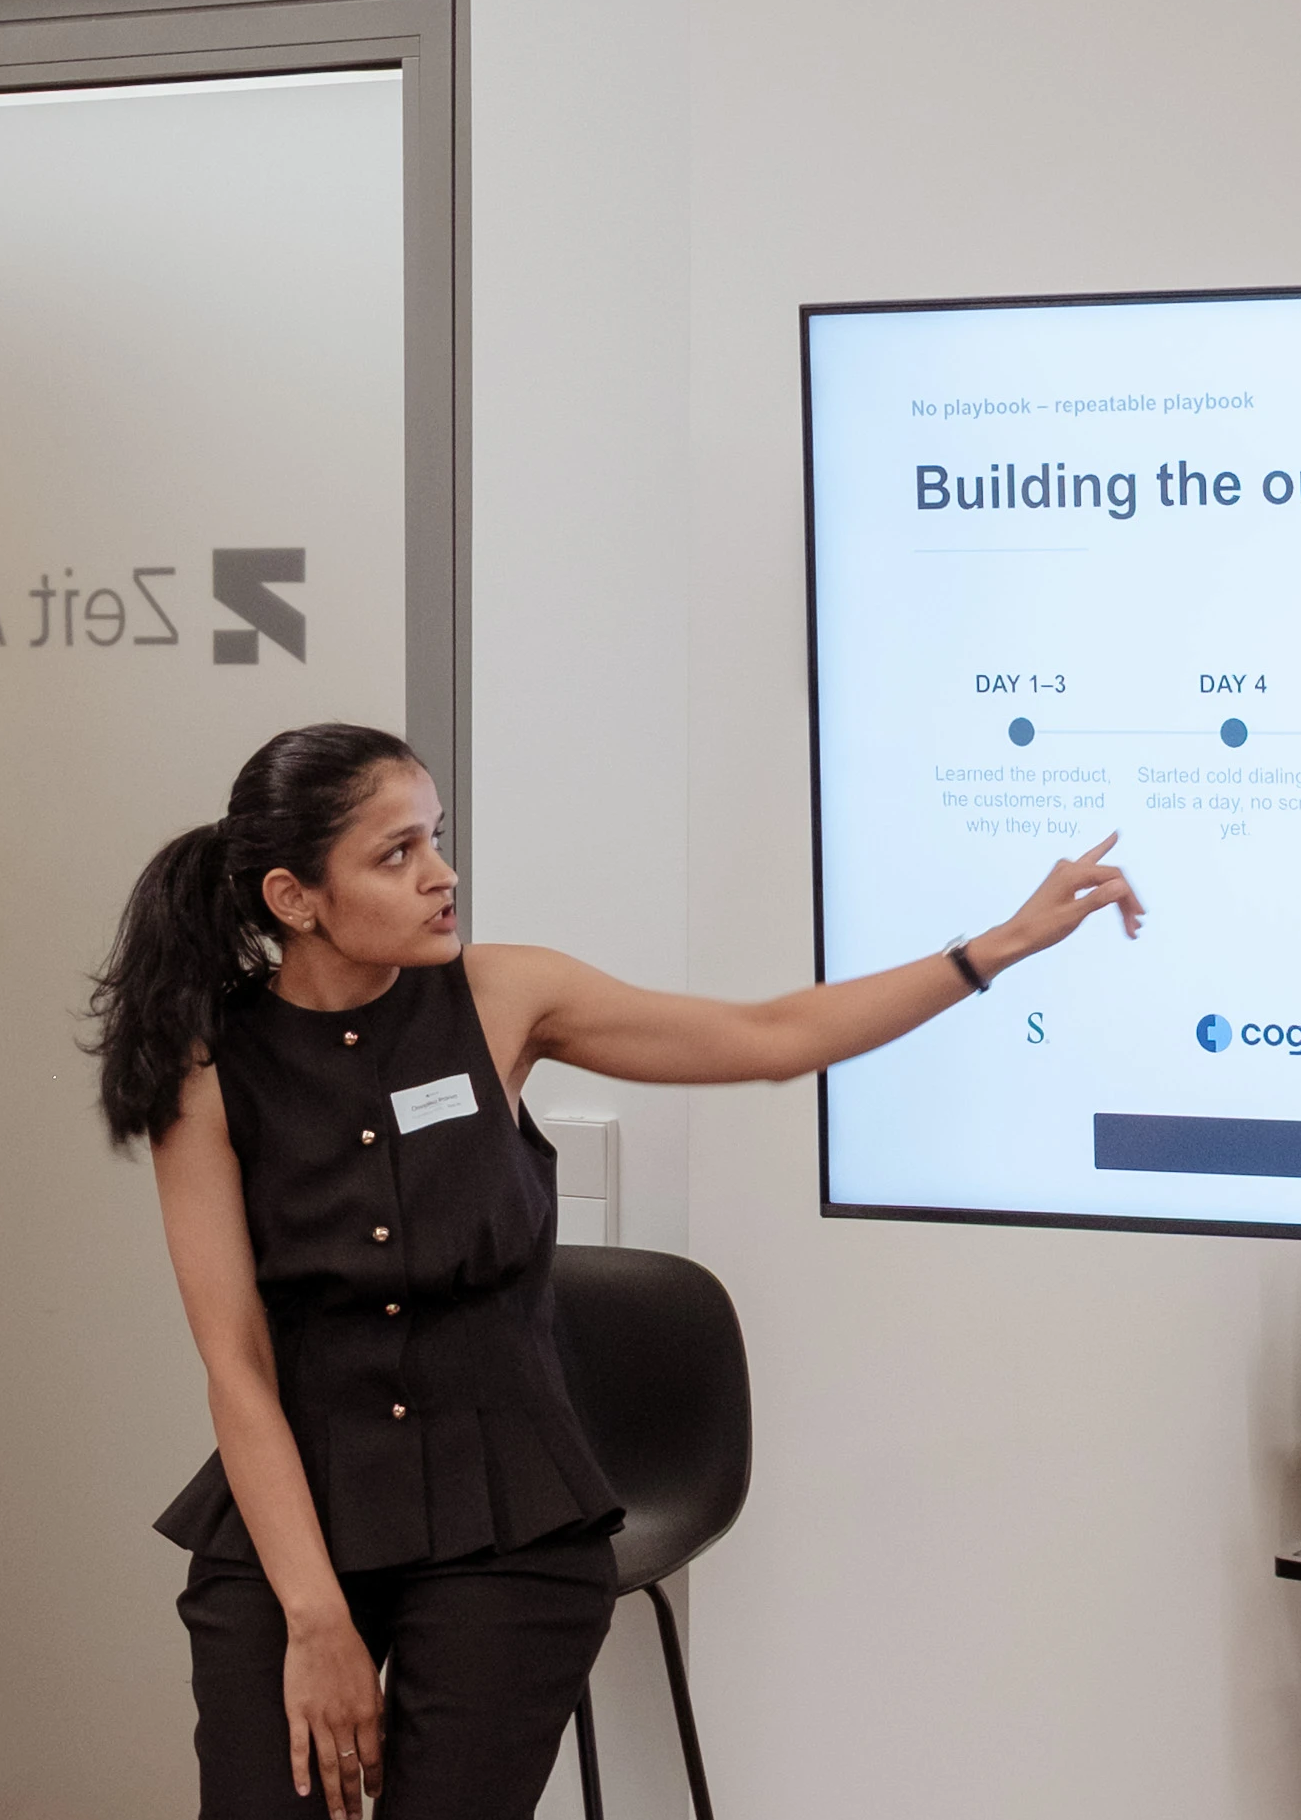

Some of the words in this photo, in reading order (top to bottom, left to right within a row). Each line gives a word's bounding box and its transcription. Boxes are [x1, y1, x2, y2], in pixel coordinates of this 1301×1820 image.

[912, 400, 937, 416] No
[944, 398, 1031, 420] playbook
[1055, 394, 1156, 417] repeatable
[1164, 391, 1254, 414] playbook
[916, 463, 1136, 520] Building
[1156, 460, 1241, 506] the
[976, 675, 1020, 693] DAY
[1200, 675, 1246, 693] DAY
[1255, 675, 1267, 693] 4
[936, 765, 1004, 782] Learned
[1010, 766, 1036, 782] the
[1137, 766, 1200, 783] Started
[1206, 767, 1242, 784] cold
[943, 791, 968, 807] the
[1073, 792, 1104, 809] and
[1146, 793, 1186, 809] dials
[1193, 797, 1202, 810] a
[1251, 797, 1272, 810] no
[966, 817, 999, 837] why
[1006, 817, 1041, 837] they
